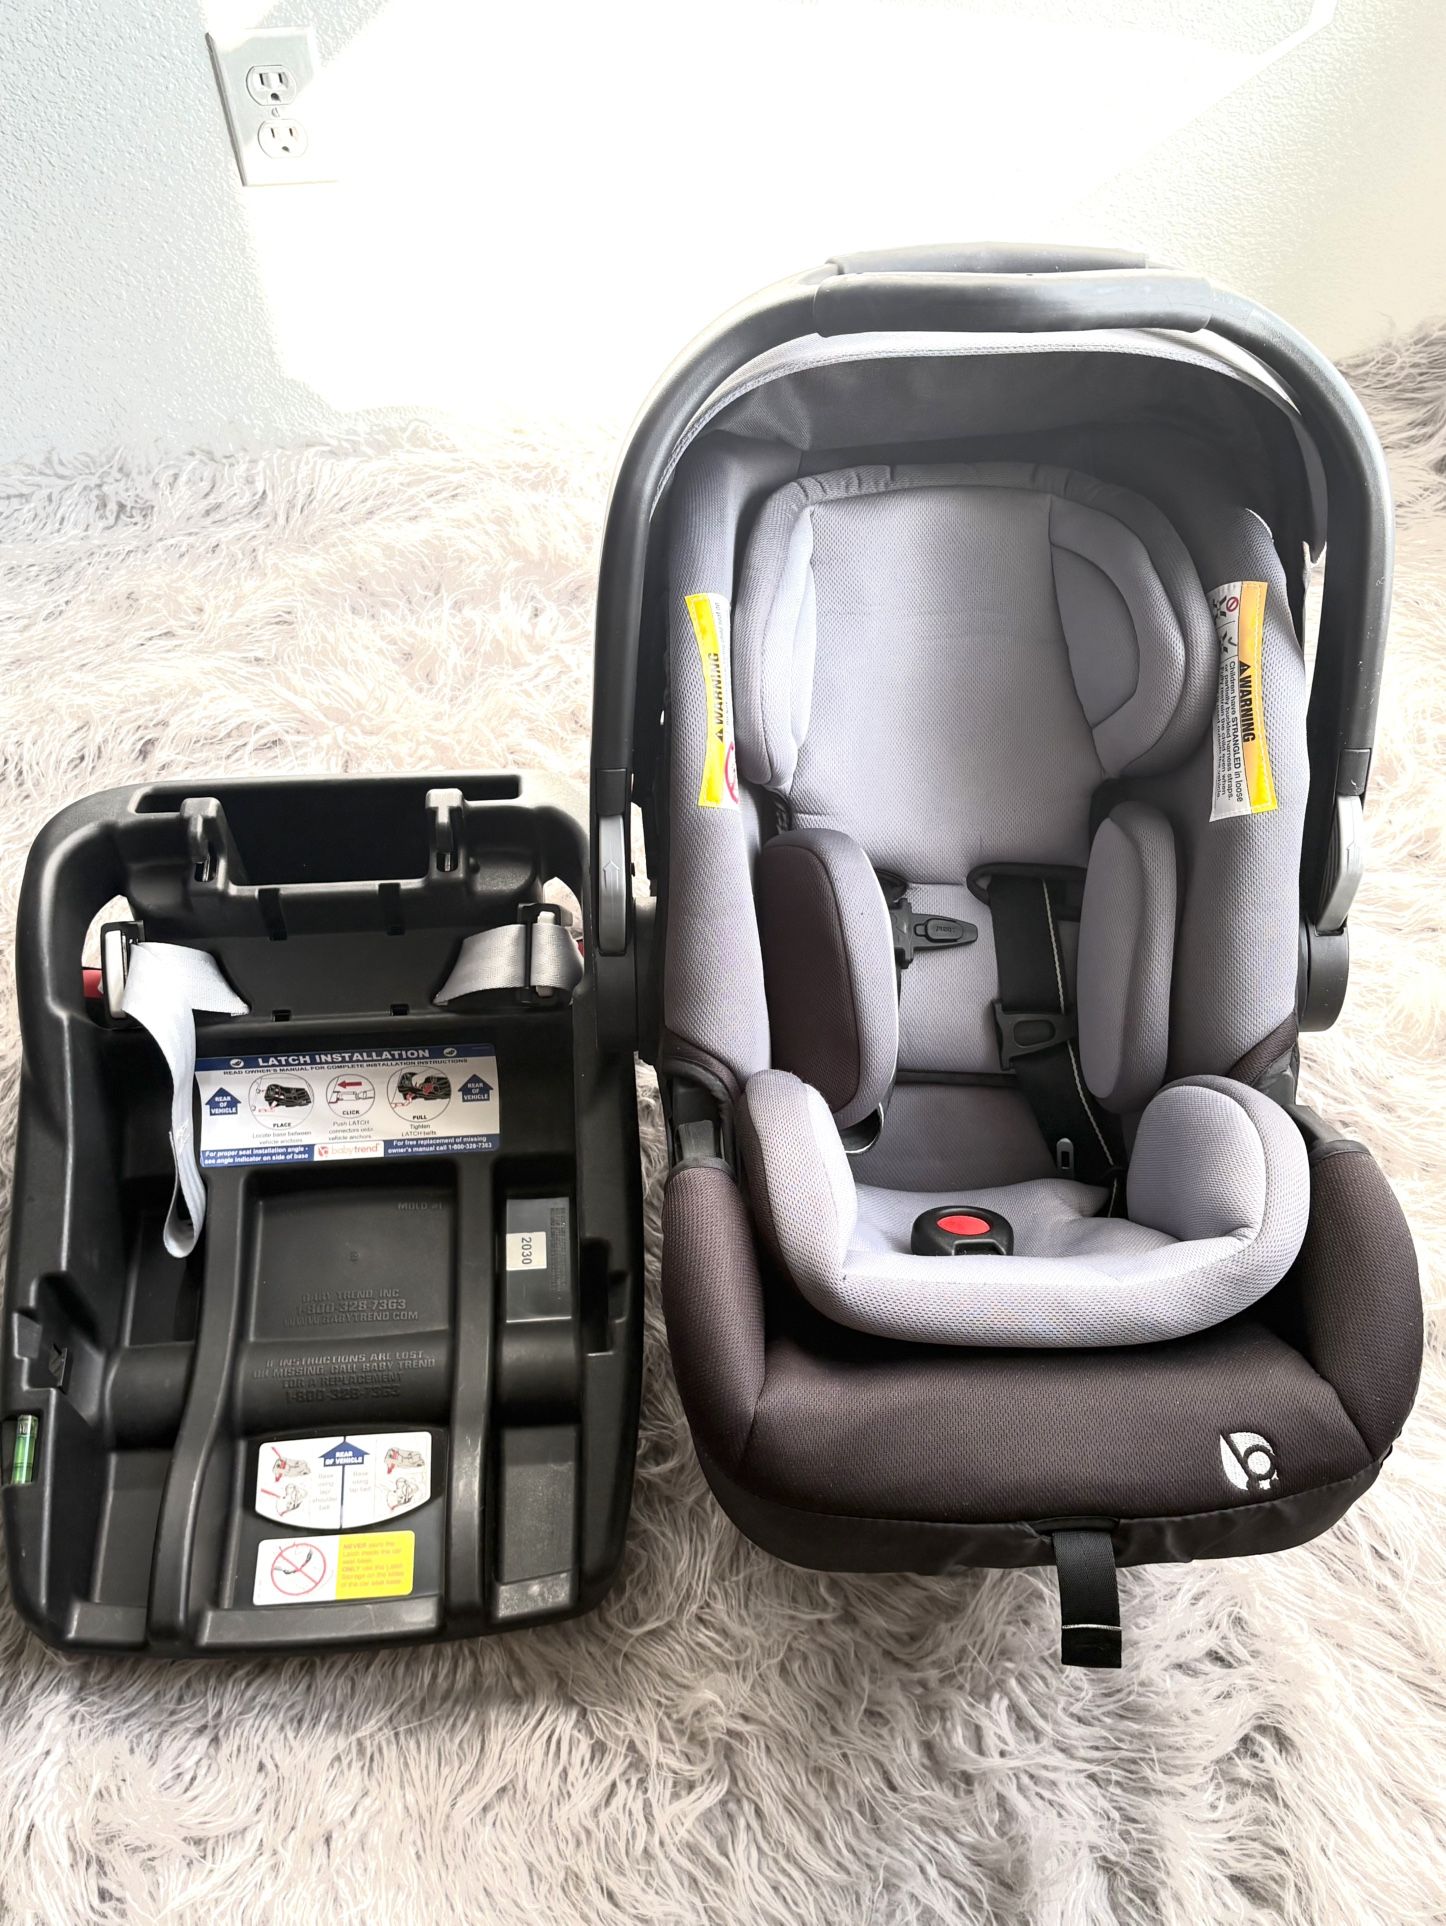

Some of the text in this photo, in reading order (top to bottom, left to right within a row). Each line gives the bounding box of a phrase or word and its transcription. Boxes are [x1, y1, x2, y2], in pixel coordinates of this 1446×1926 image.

[708, 653, 723, 725] WARNING
[1240, 675, 1256, 742] WARNING
[1232, 717, 1242, 769] STRANGLED
[1234, 771, 1242, 779] in
[1234, 780, 1244, 802] loose
[258, 1049, 430, 1066] LATCH INSTALLATION
[216, 1150, 238, 1158] proper
[521, 1236, 532, 1264] 2030
[280, 1354, 366, 1368] INSTRUCTIONS
[331, 1364, 358, 1374] CALL
[362, 1361, 394, 1372] BABY
[398, 1358, 436, 1369] TREND
[320, 1372, 402, 1388] REPLACEMENT
[336, 1456, 363, 1464] VEHICLE
